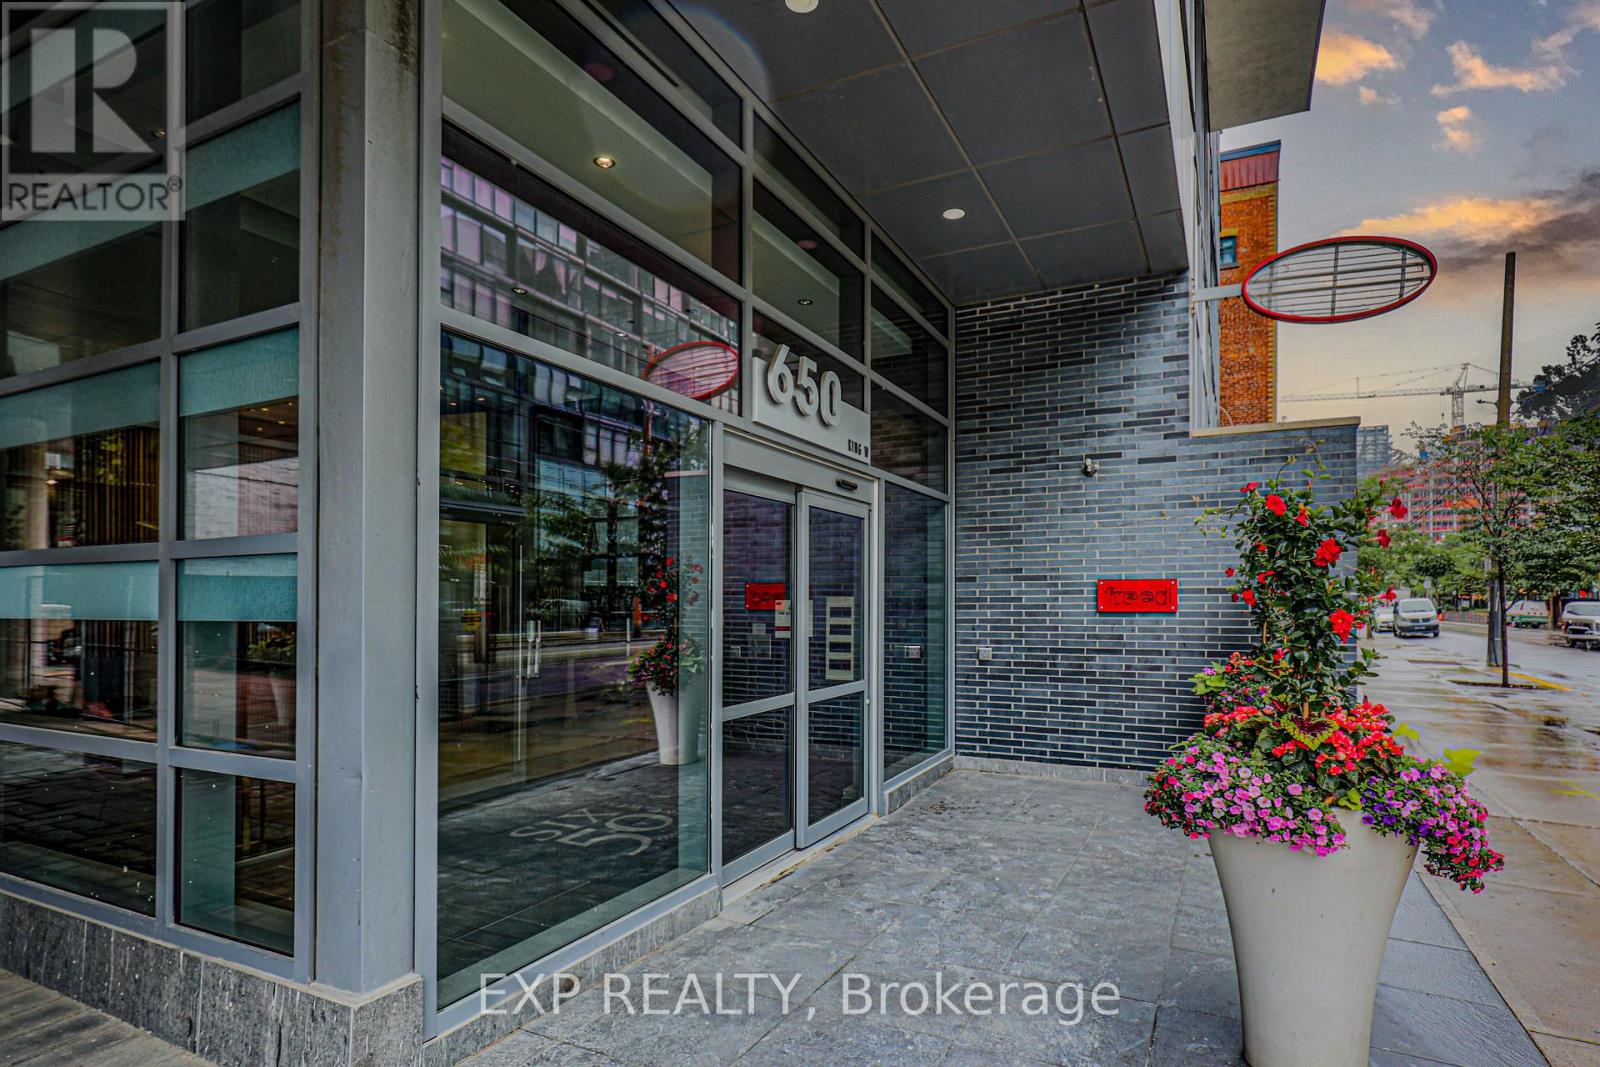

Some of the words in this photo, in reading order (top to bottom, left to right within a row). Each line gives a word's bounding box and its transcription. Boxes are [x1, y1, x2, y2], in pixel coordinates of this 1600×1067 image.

[767, 344, 842, 427] 650
[847, 438, 862, 456] KING
[510, 807, 622, 842] SIX
[556, 813, 674, 856] 50
